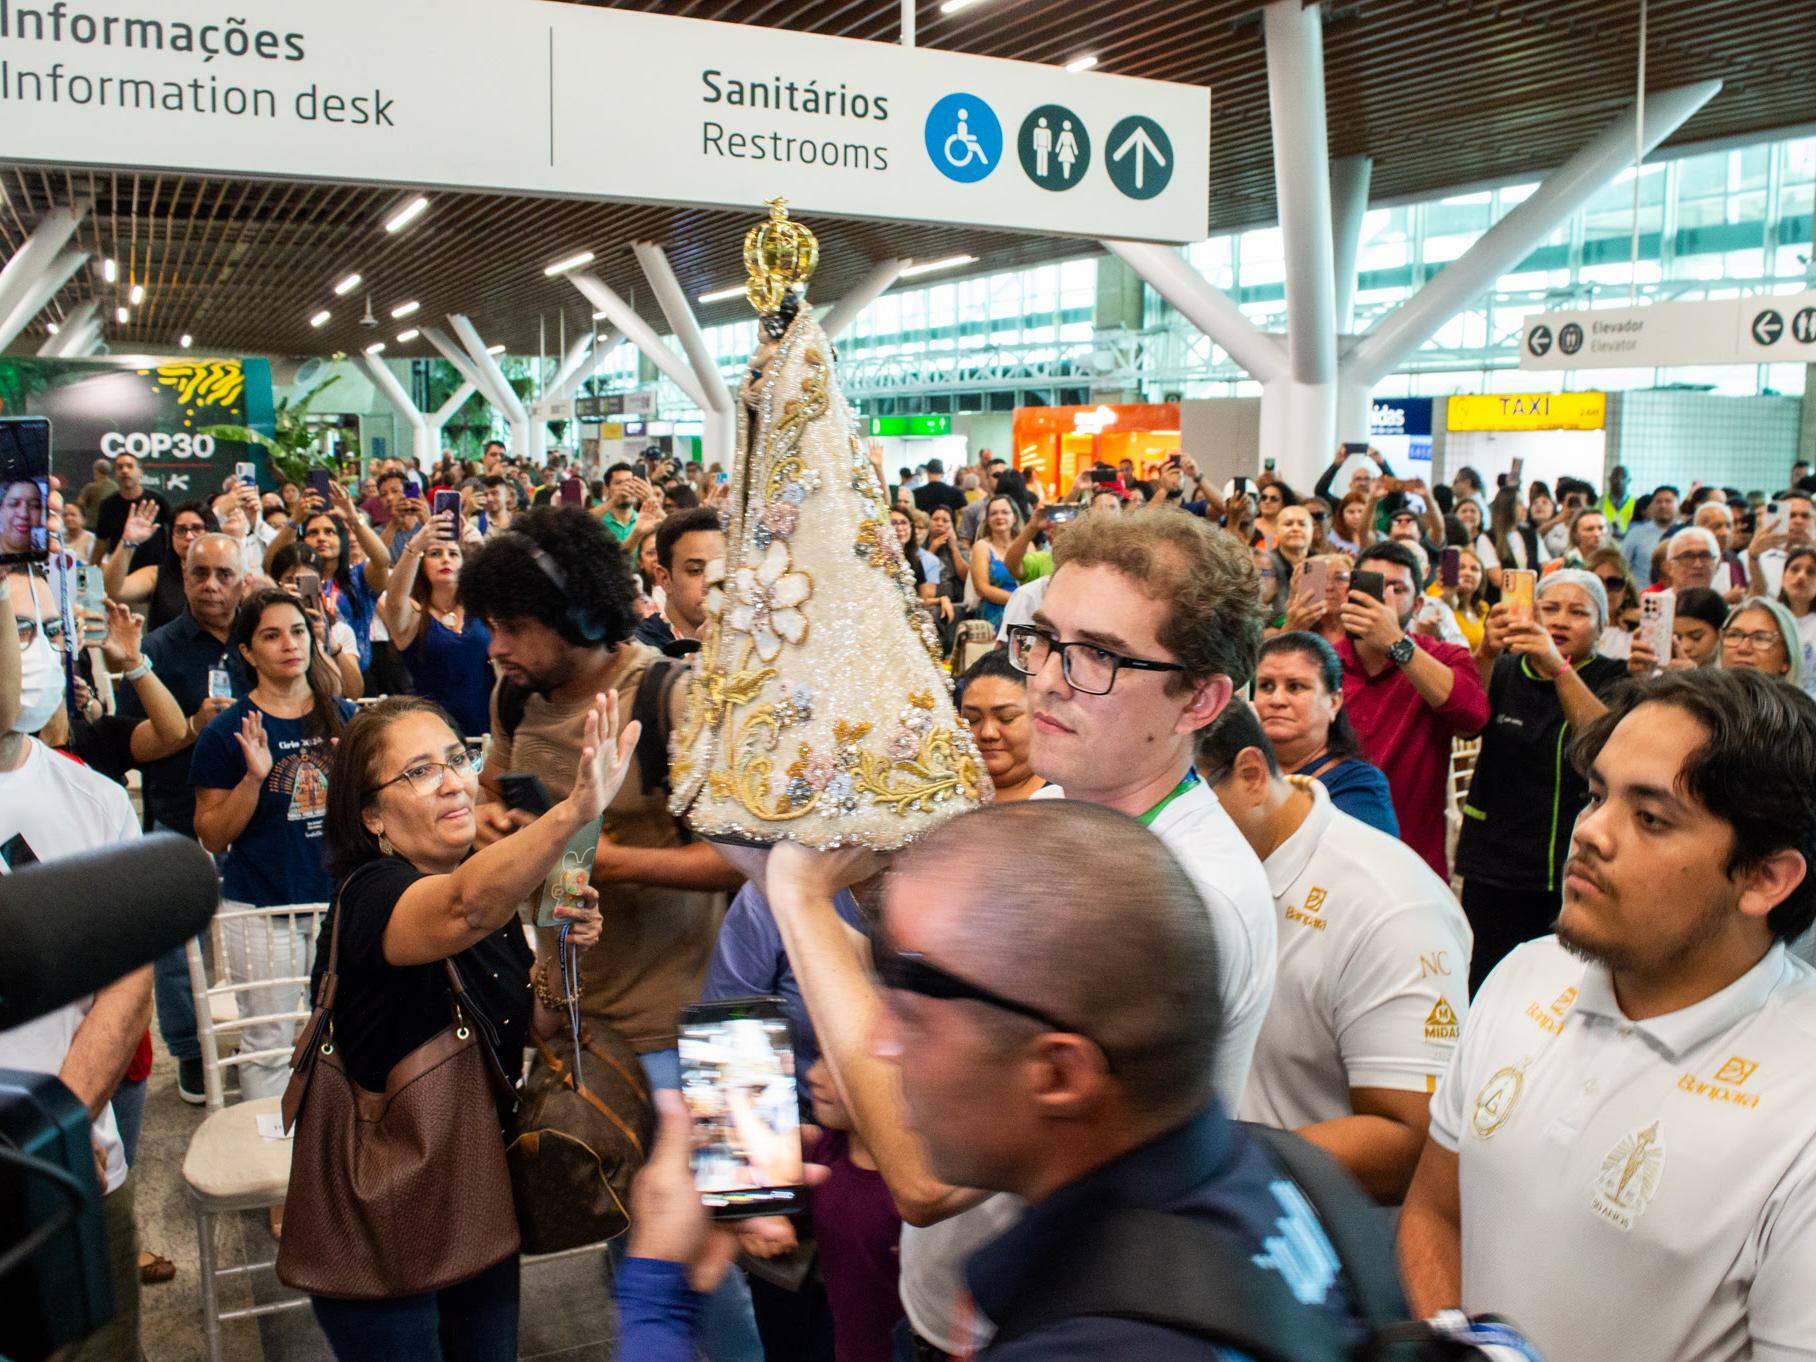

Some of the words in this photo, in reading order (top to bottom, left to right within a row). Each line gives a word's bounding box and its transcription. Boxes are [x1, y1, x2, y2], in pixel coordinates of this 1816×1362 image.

[0, 0, 306, 63] Informações
[2, 60, 277, 118] Information
[295, 83, 396, 127] desk
[702, 69, 889, 121] Sanitários
[702, 122, 889, 171] Restrooms
[1592, 319, 1645, 335] Elevador
[1591, 339, 1638, 354] Elevator
[1500, 397, 1549, 416] TAXI
[100, 431, 216, 459] COP30
